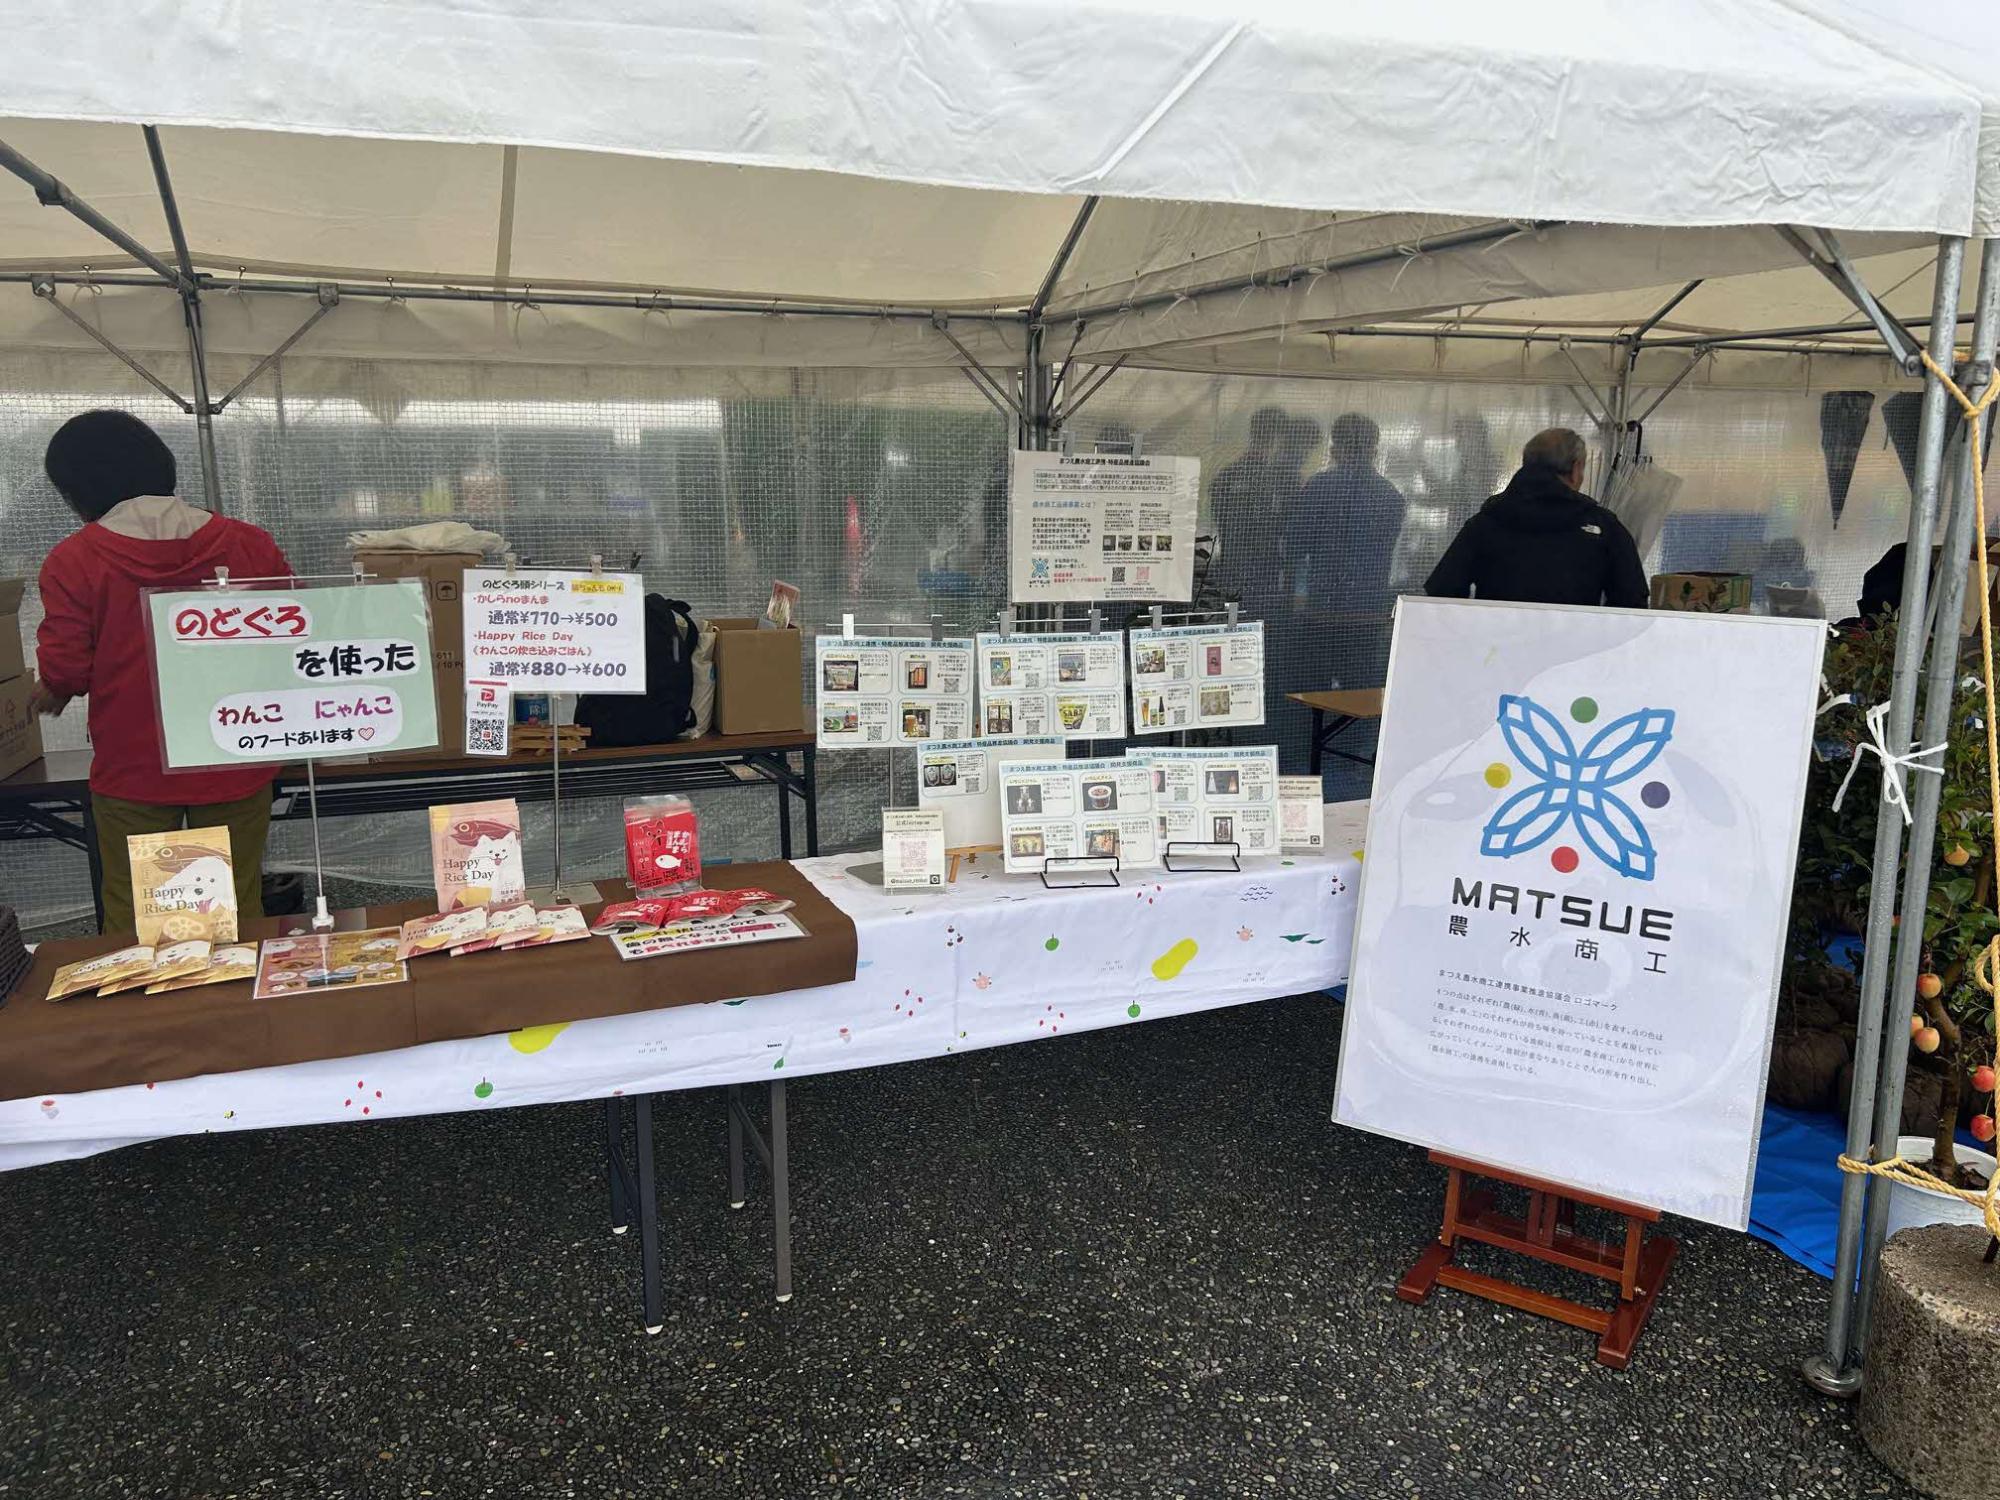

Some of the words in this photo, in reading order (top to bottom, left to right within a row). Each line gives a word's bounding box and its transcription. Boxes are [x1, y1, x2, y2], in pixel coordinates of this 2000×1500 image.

[175, 605, 307, 637] のどぐろ
[522, 631, 546, 641] Rice
[552, 632, 573, 642] Day
[296, 643, 416, 678] を使った
[217, 703, 284, 725] わんこ
[315, 696, 394, 719] にゃんこ
[443, 858, 480, 870] Happy
[444, 872, 468, 882] Rice
[471, 870, 494, 881] Day
[143, 887, 186, 899] Happy
[144, 903, 173, 914] Rice
[176, 900, 201, 912] Day
[1452, 877, 1674, 942] MATSUE
[1574, 997, 1618, 1011] ロゴマーク
